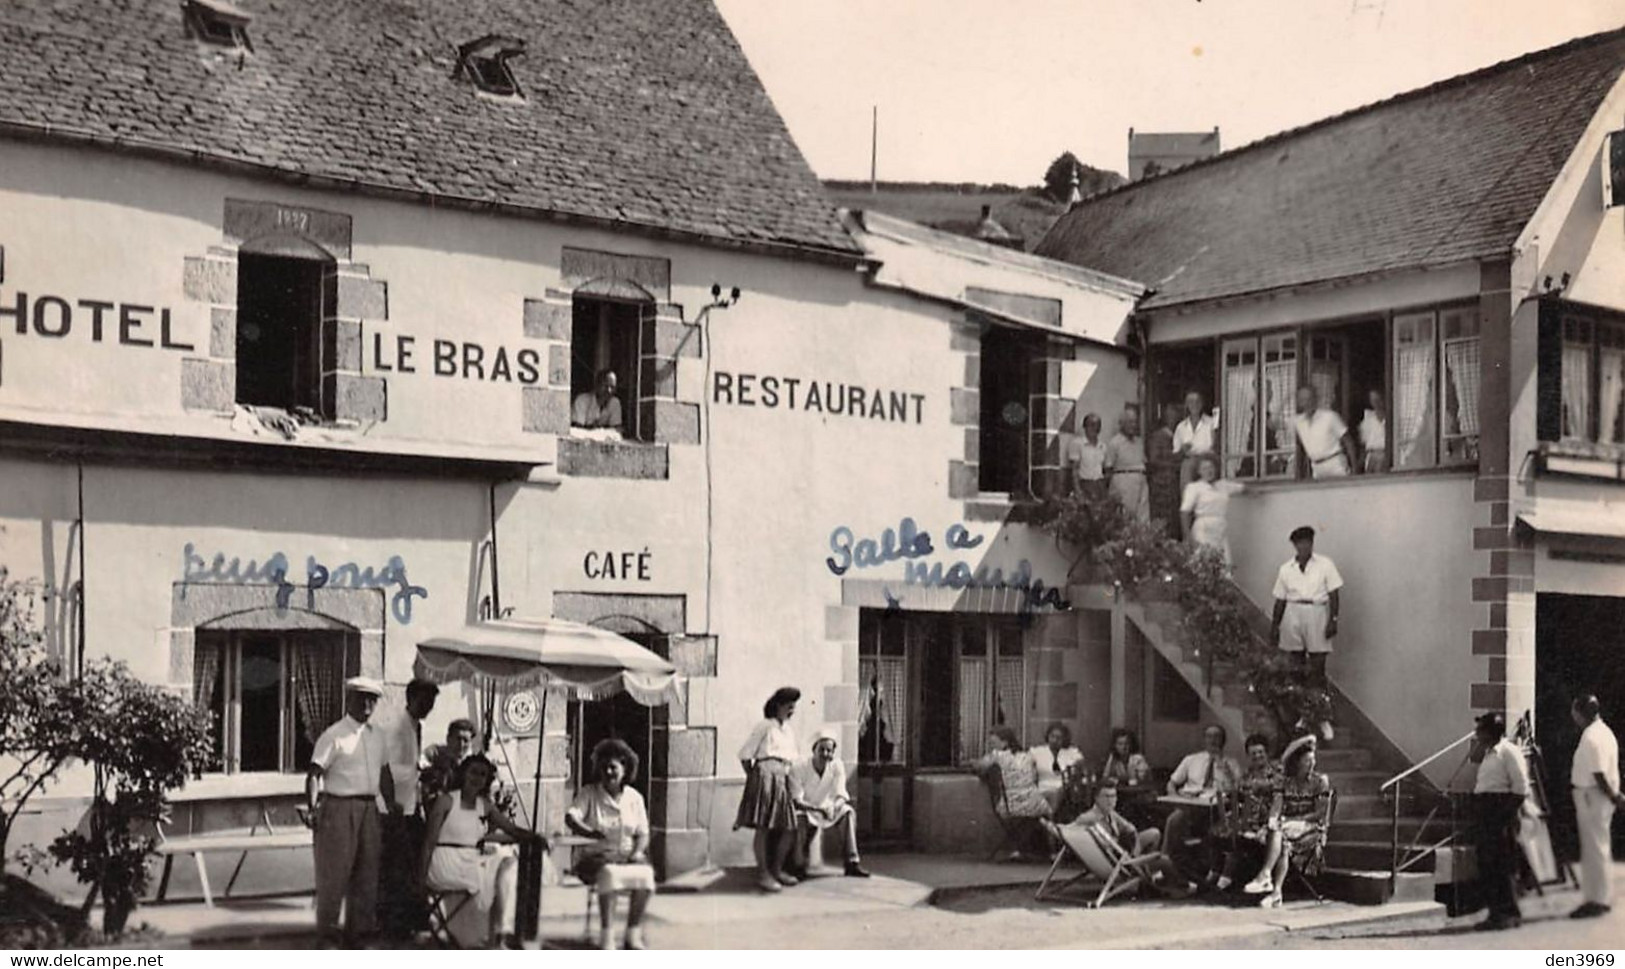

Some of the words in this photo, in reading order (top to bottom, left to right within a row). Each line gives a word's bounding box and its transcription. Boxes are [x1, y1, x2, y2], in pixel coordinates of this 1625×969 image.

[0, 291, 195, 351] HOTEL
[374, 333, 416, 373] LE
[433, 339, 540, 384] BRAS
[713, 371, 926, 424] RESTAURANT
[584, 546, 652, 580] CAFÉ
